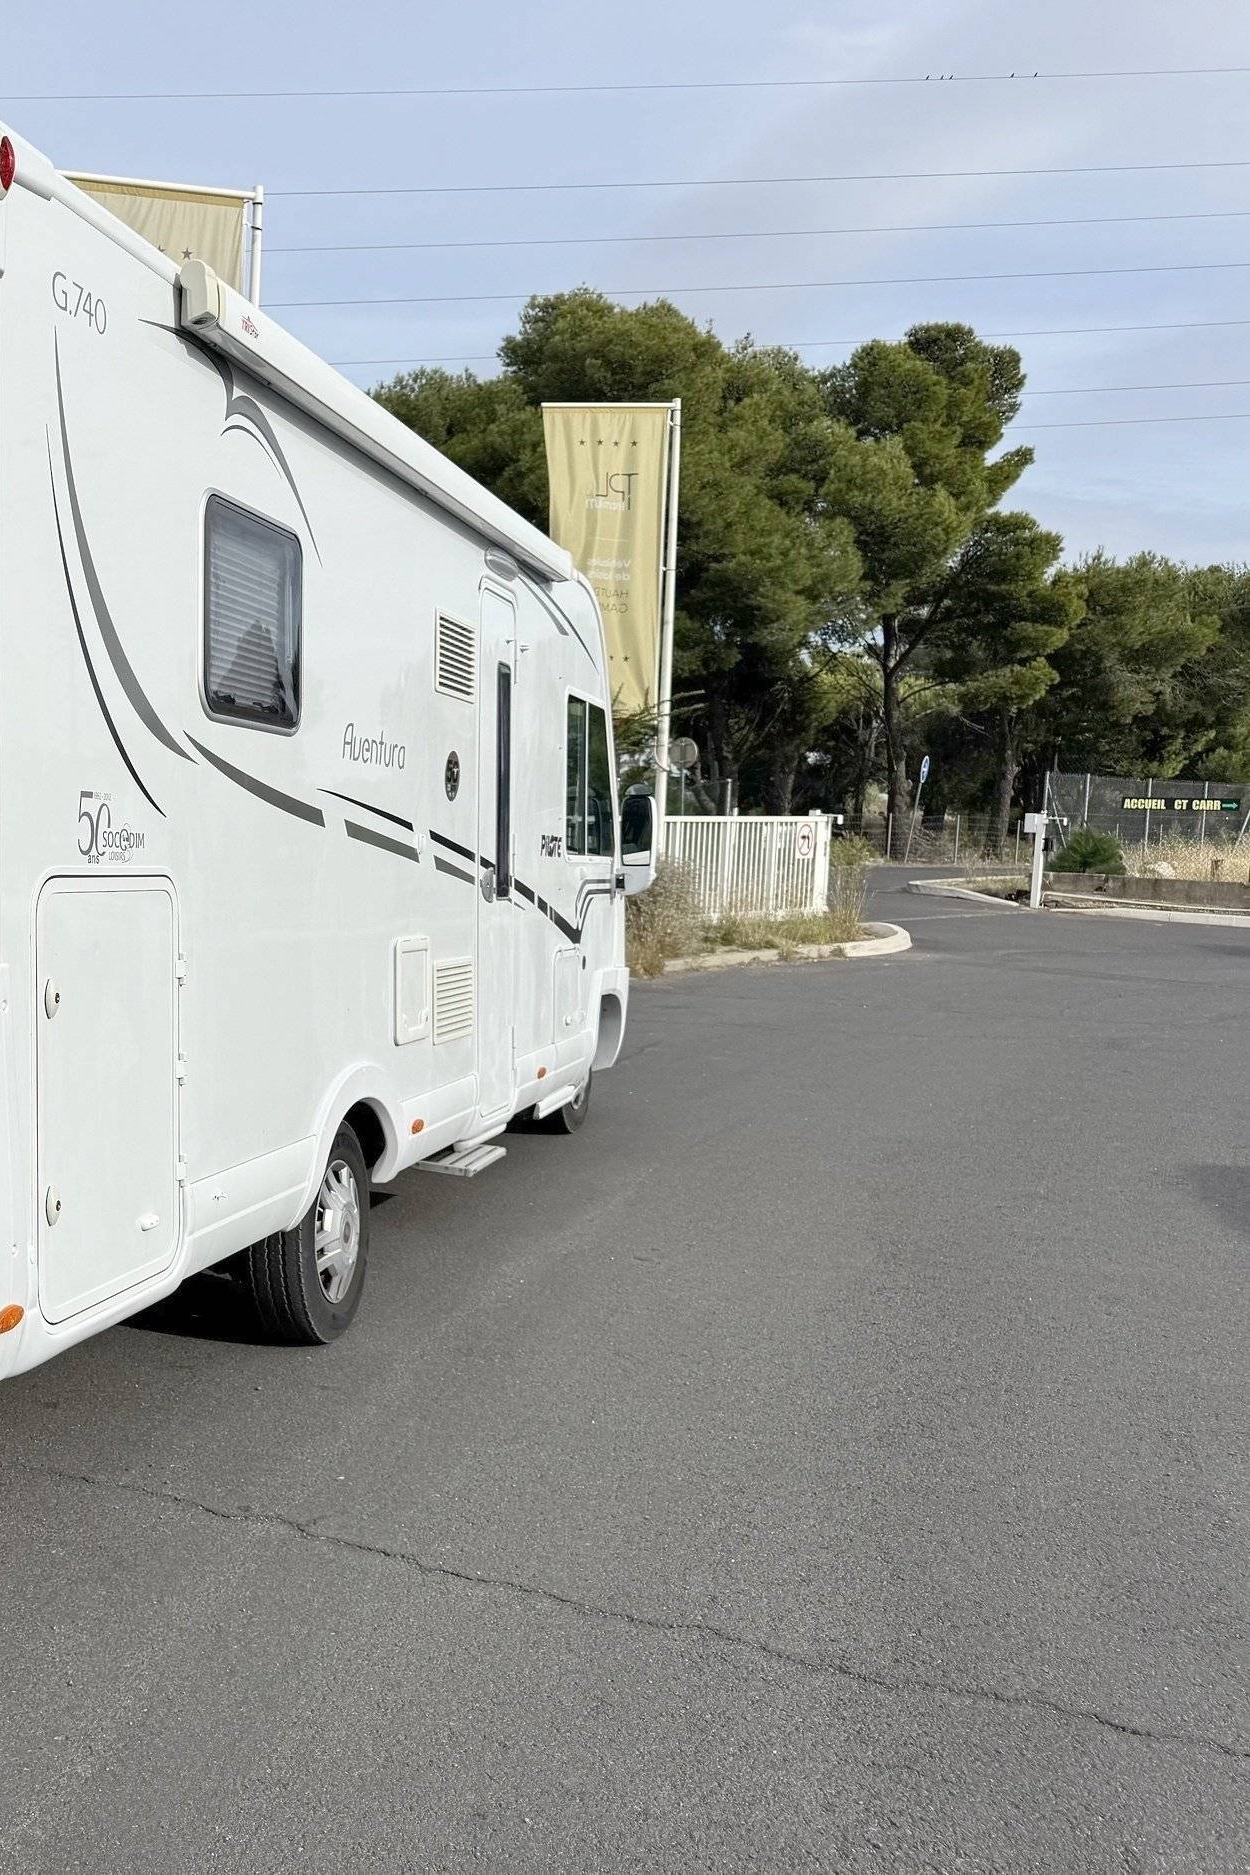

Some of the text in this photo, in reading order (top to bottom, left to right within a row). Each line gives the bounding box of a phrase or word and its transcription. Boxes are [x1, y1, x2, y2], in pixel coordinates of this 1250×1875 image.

[52, 271, 107, 335] G.740
[342, 722, 406, 770] Aventura
[1123, 798, 1222, 811] ACCUEIL CT CARR
